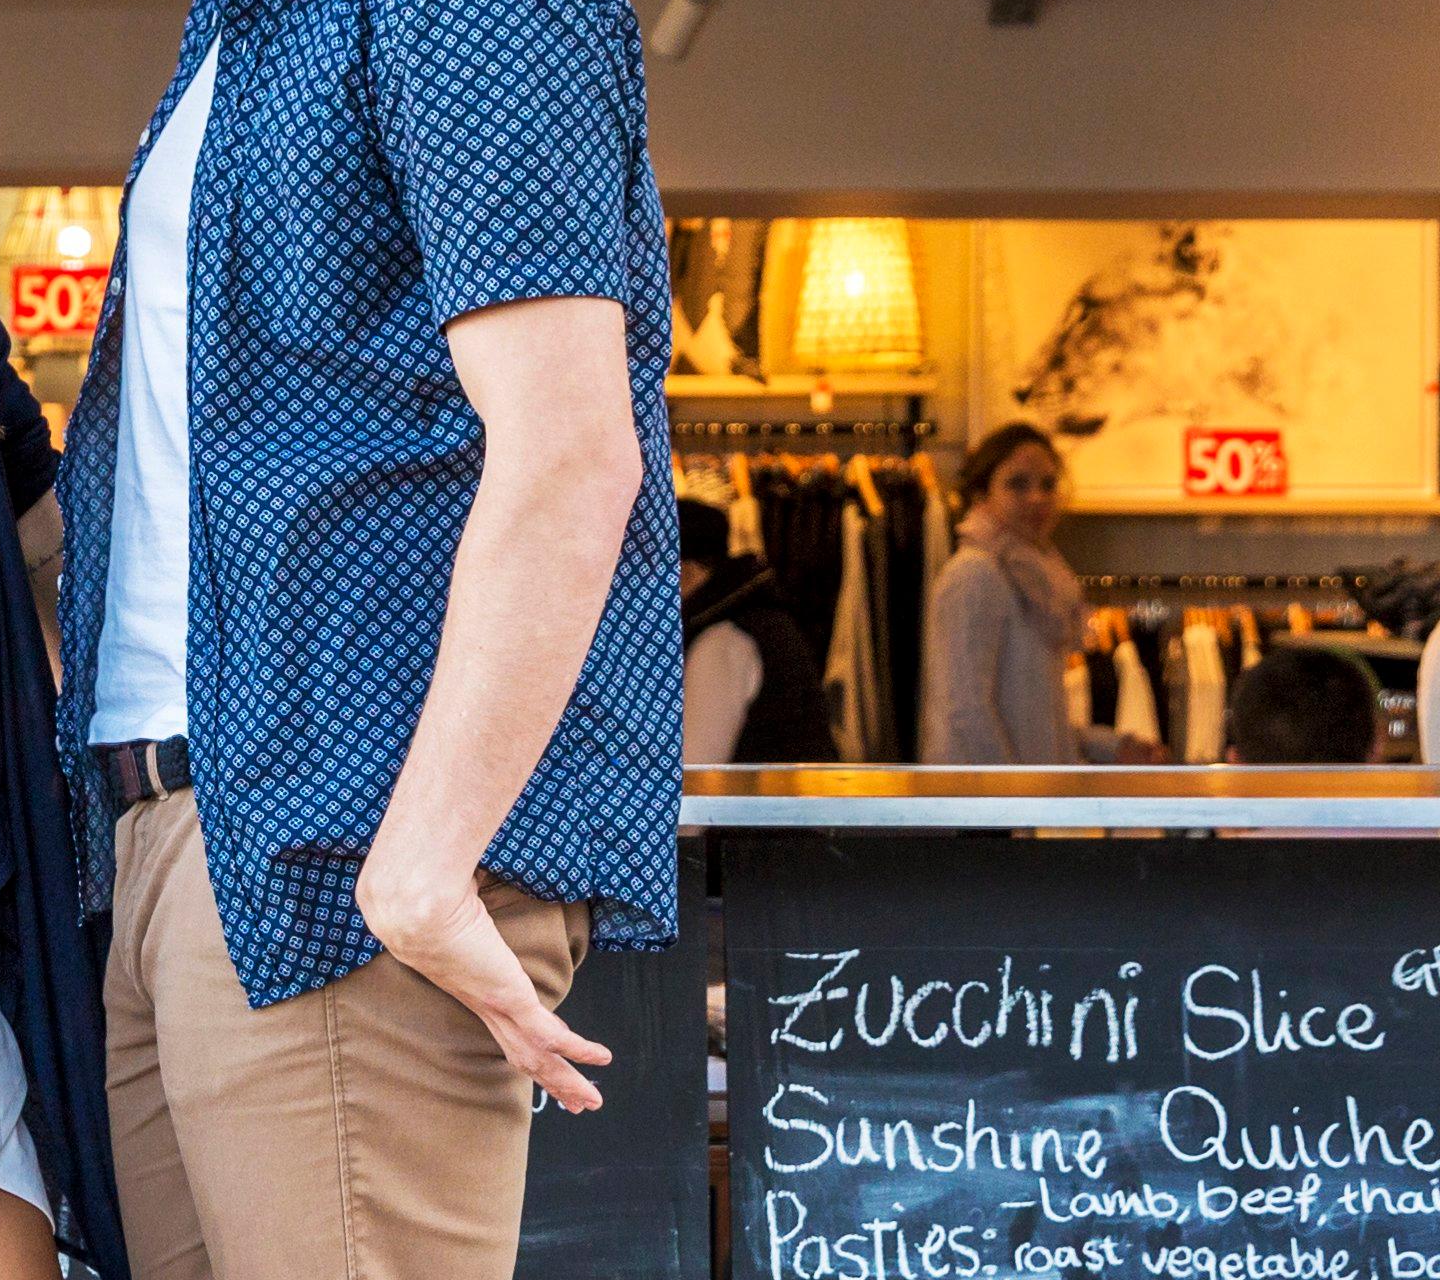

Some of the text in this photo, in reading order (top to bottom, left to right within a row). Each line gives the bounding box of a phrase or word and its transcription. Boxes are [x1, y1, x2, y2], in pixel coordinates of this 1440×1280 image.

[768, 947, 1142, 1063] Zucchini
[1183, 963, 1386, 1062] Slice
[763, 1082, 1108, 1180] Sunshine
[1014, 1237, 1125, 1272] roast
